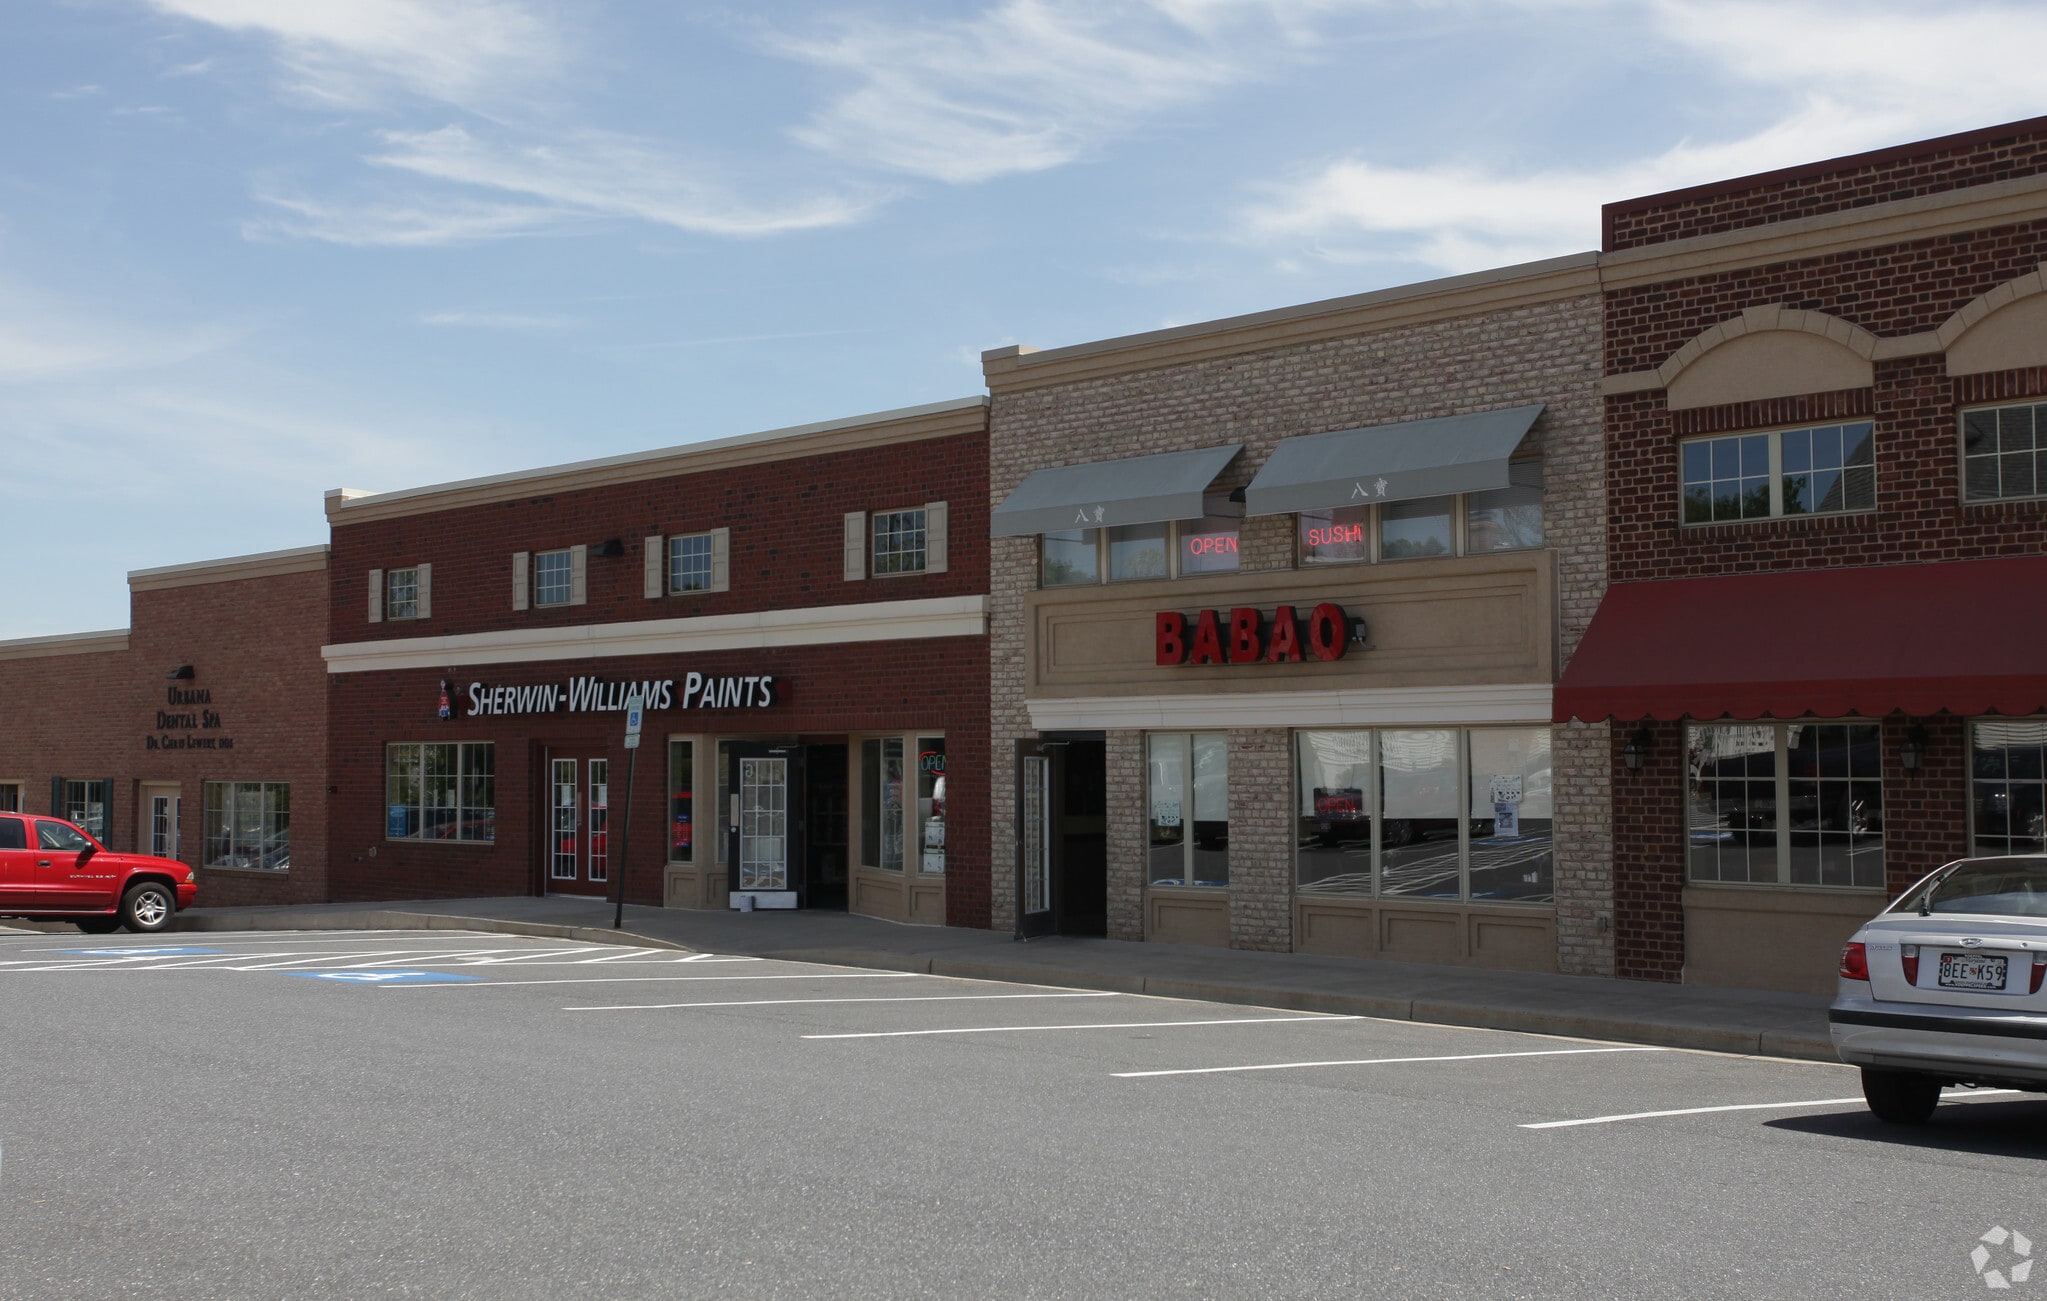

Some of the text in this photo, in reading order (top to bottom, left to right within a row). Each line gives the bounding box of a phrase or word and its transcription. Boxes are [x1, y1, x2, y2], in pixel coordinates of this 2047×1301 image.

[1308, 523, 1363, 545] SUSHI
[1190, 536, 1238, 555] OPEN
[1156, 602, 1345, 666] BABAO
[167, 686, 212, 705] URBANA
[467, 672, 772, 716] SHERWIN-WILLIAMS PAINTS
[157, 709, 221, 729] DENTAL SPA
[1317, 797, 1355, 813] OPEN
[1943, 963, 2003, 982] 8EE K59
